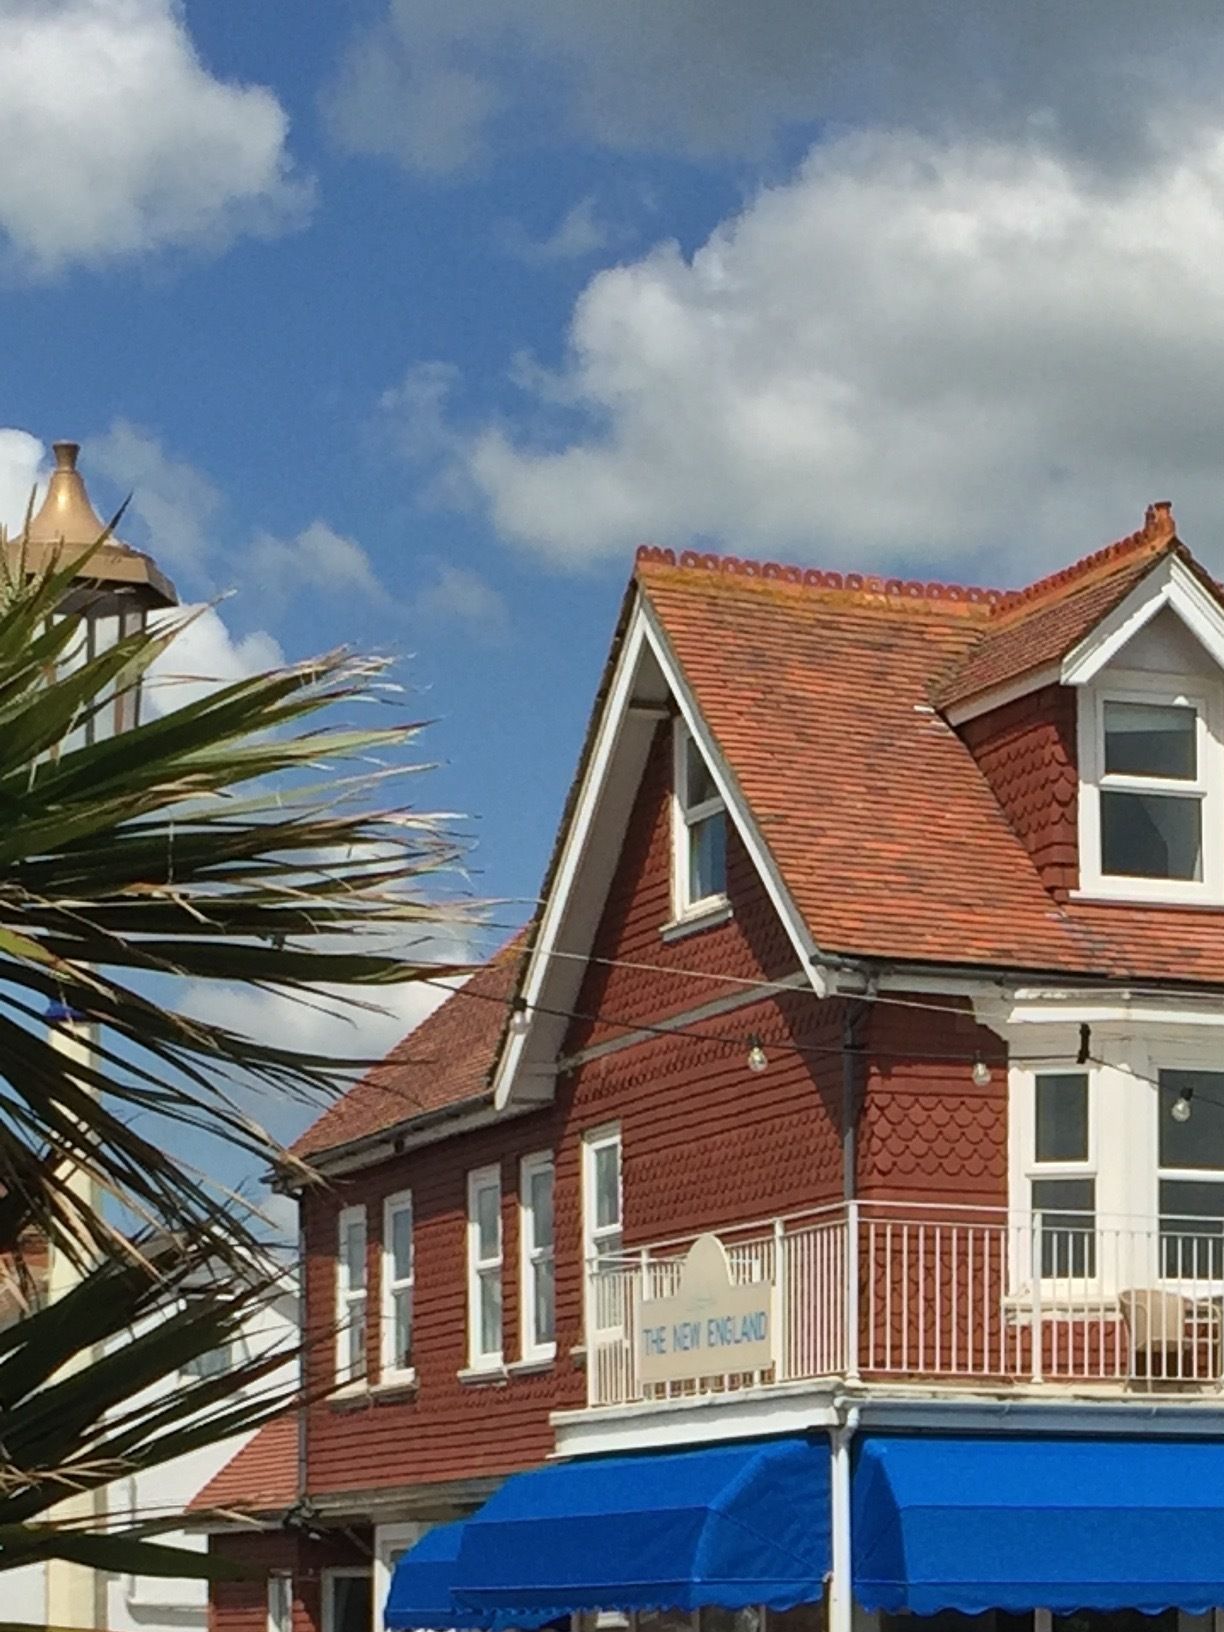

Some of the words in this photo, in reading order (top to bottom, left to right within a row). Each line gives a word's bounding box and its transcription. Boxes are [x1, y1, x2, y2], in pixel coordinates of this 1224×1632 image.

[643, 1326, 666, 1356] THE
[673, 1321, 701, 1352] NEW
[708, 1311, 767, 1348] ENGLAND
